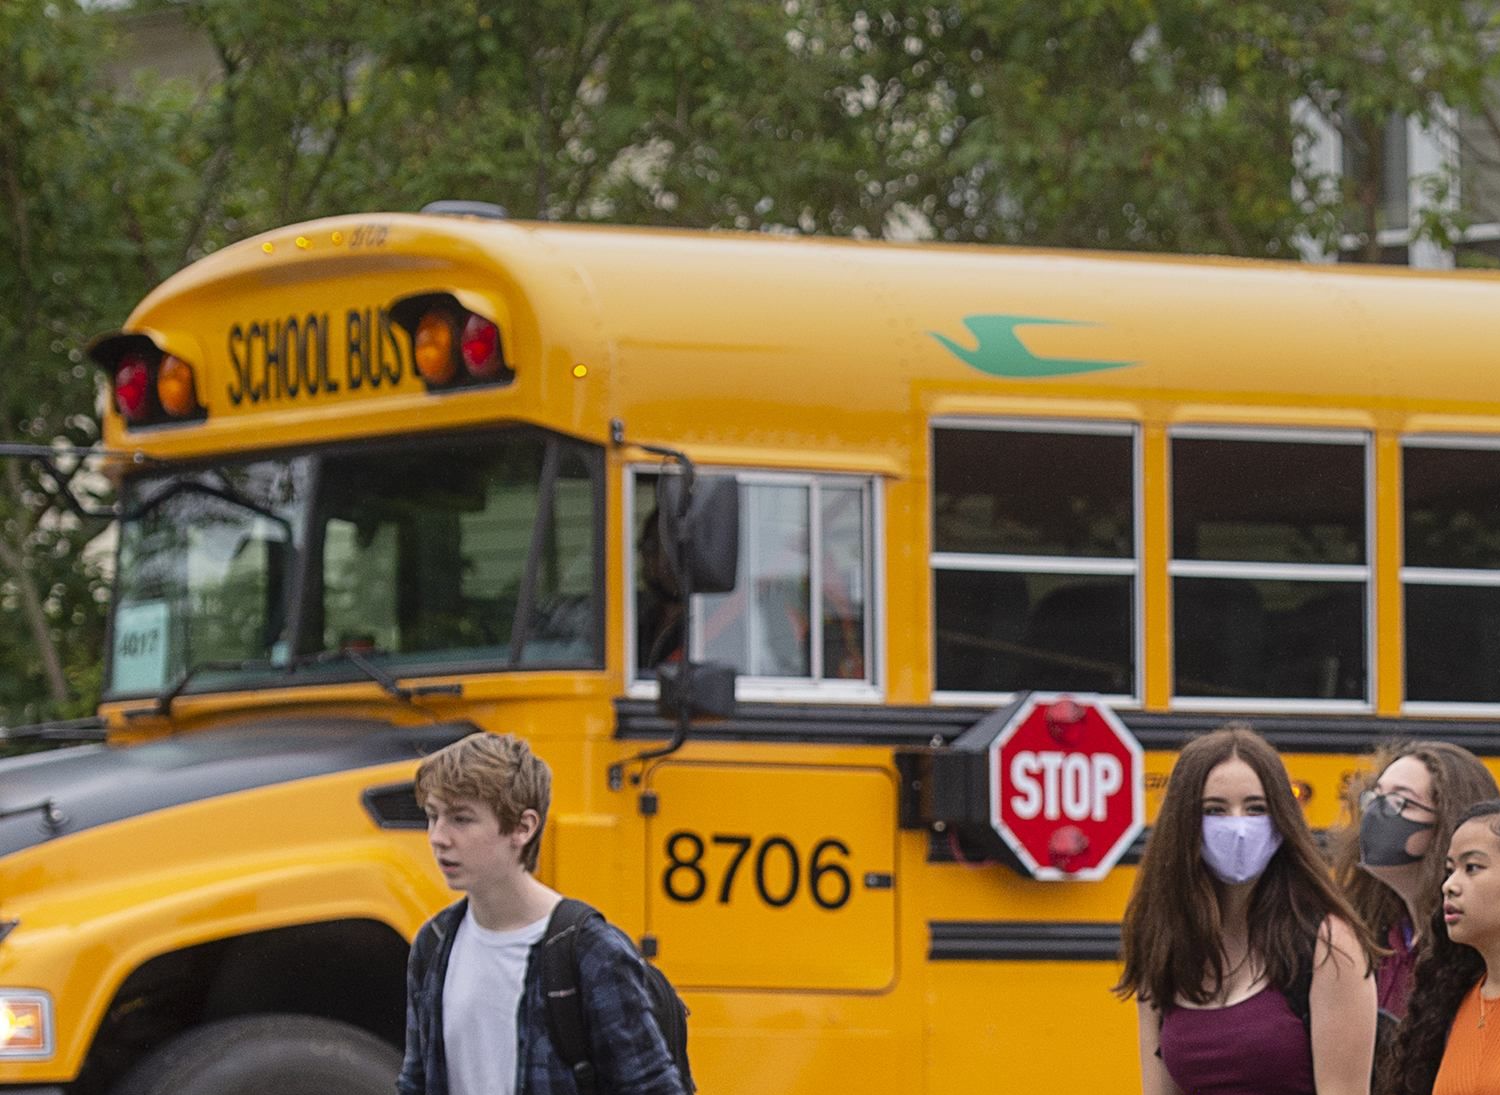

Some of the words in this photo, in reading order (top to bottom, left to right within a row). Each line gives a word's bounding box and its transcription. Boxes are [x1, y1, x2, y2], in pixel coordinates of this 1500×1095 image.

[228, 312, 339, 406] SCHOOL
[347, 306, 403, 389] BUS
[1010, 750, 1124, 822] STOP
[663, 831, 852, 911] 8706
